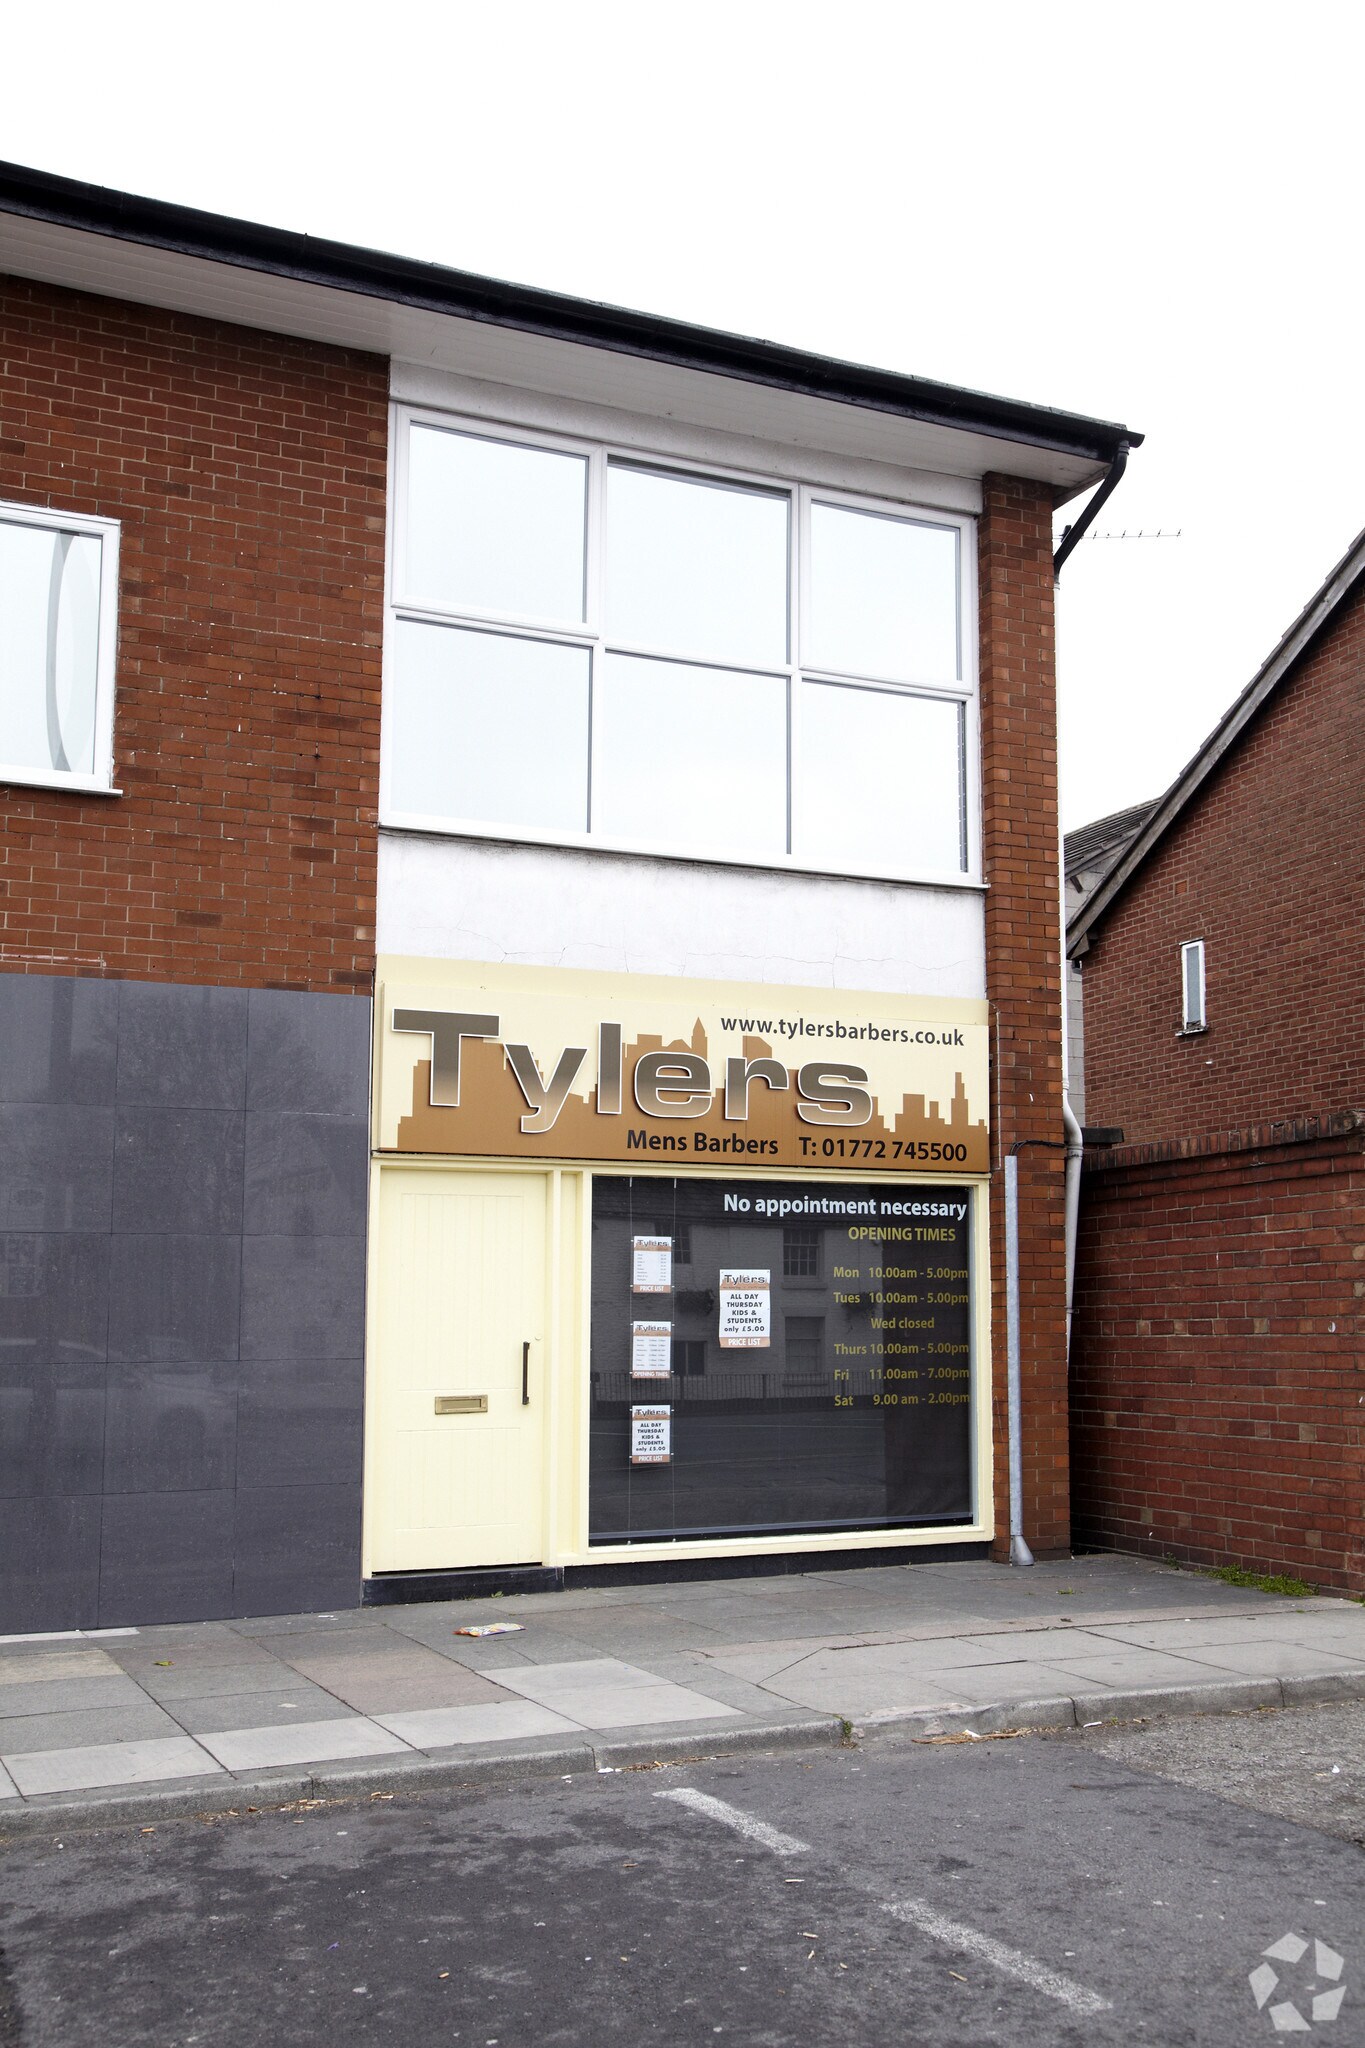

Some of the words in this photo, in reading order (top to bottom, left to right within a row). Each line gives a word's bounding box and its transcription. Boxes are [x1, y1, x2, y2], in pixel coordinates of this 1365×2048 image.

[720, 1015, 965, 1046] www.tylersbarbers.co.uk
[391, 1006, 874, 1134] Tylers
[626, 1130, 690, 1152] Mens
[694, 1134, 779, 1155] Barbers
[798, 1136, 817, 1156] T:
[821, 1136, 887, 1159] 01772
[891, 1138, 968, 1162] 745500
[724, 1194, 750, 1212] No
[755, 1195, 876, 1216] appointment
[880, 1201, 967, 1221] necessary
[848, 1227, 912, 1241] OPENING
[914, 1228, 956, 1241] TIMES
[724, 1274, 765, 1285] Tylers
[833, 1267, 859, 1278] Mon
[869, 1267, 918, 1278] 10.00am
[927, 1267, 969, 1280] 5.00pm
[833, 1292, 860, 1303] Tues
[869, 1293, 918, 1304] 10.00am
[927, 1292, 969, 1305] 5.00pm
[724, 1325, 740, 1333] only
[871, 1318, 896, 1329] Wed
[898, 1317, 935, 1329] closed
[728, 1338, 747, 1346] PRICE
[748, 1338, 761, 1346] LIST
[834, 1343, 867, 1355] Thurs
[870, 1344, 918, 1354] 10.00am
[927, 1343, 969, 1356] 5.00pm
[834, 1368, 849, 1380] Fri
[870, 1368, 918, 1379] 11.00am
[927, 1368, 969, 1381] 7.00pm
[834, 1395, 853, 1406] Sat
[873, 1394, 899, 1405] 9.00
[901, 1396, 919, 1404] am
[928, 1393, 970, 1405] 2.00pm
